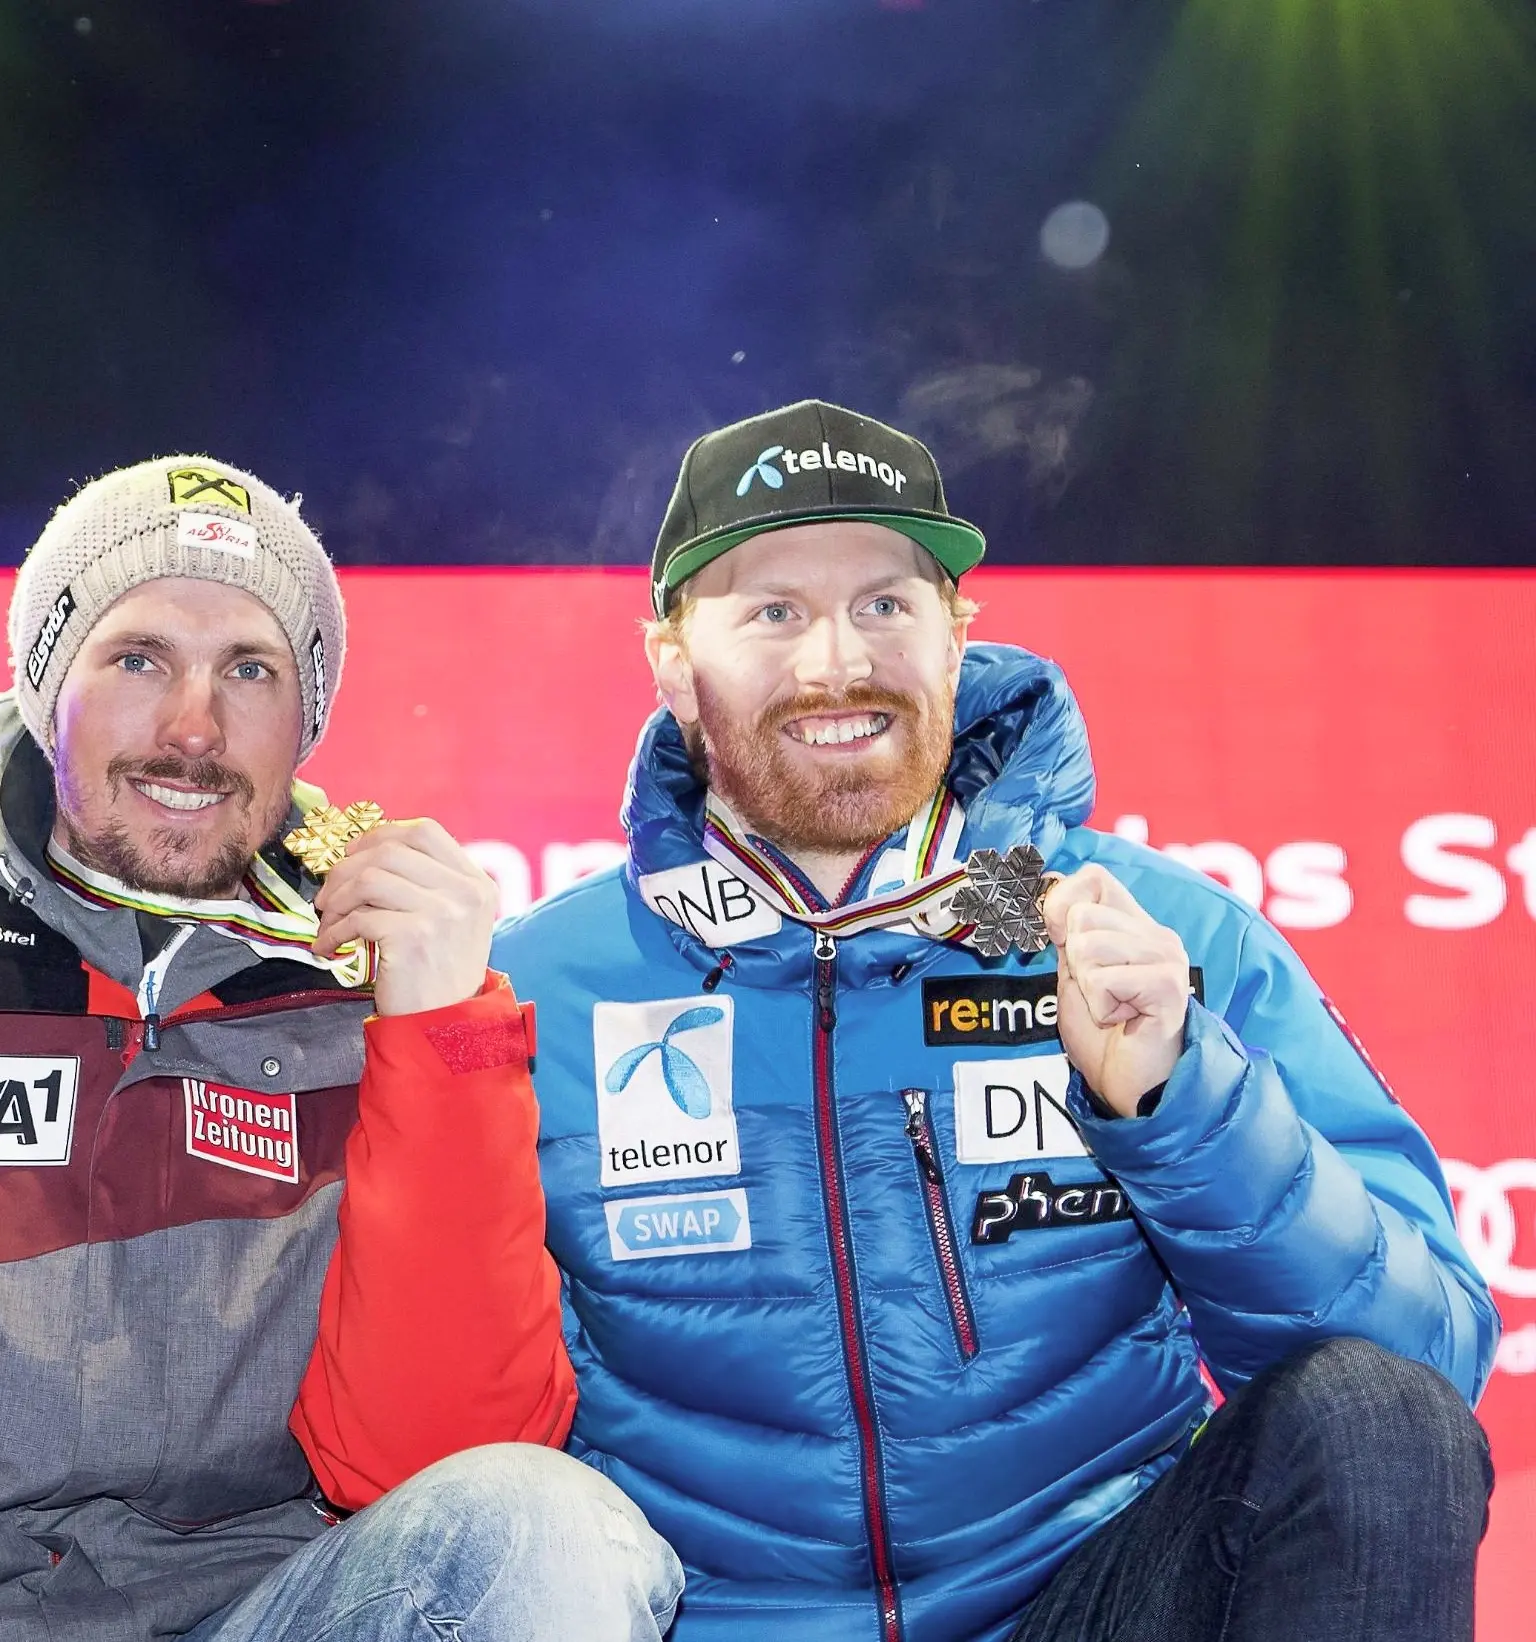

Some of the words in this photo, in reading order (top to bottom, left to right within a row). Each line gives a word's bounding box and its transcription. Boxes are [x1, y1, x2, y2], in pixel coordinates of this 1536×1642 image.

[782, 441, 907, 493] telenor
[932, 993, 1058, 1032] re:me
[192, 1081, 291, 1132] Kronen
[193, 1109, 293, 1168] Zeitung
[609, 1138, 729, 1173] telenor
[633, 1208, 721, 1242] SWAP
